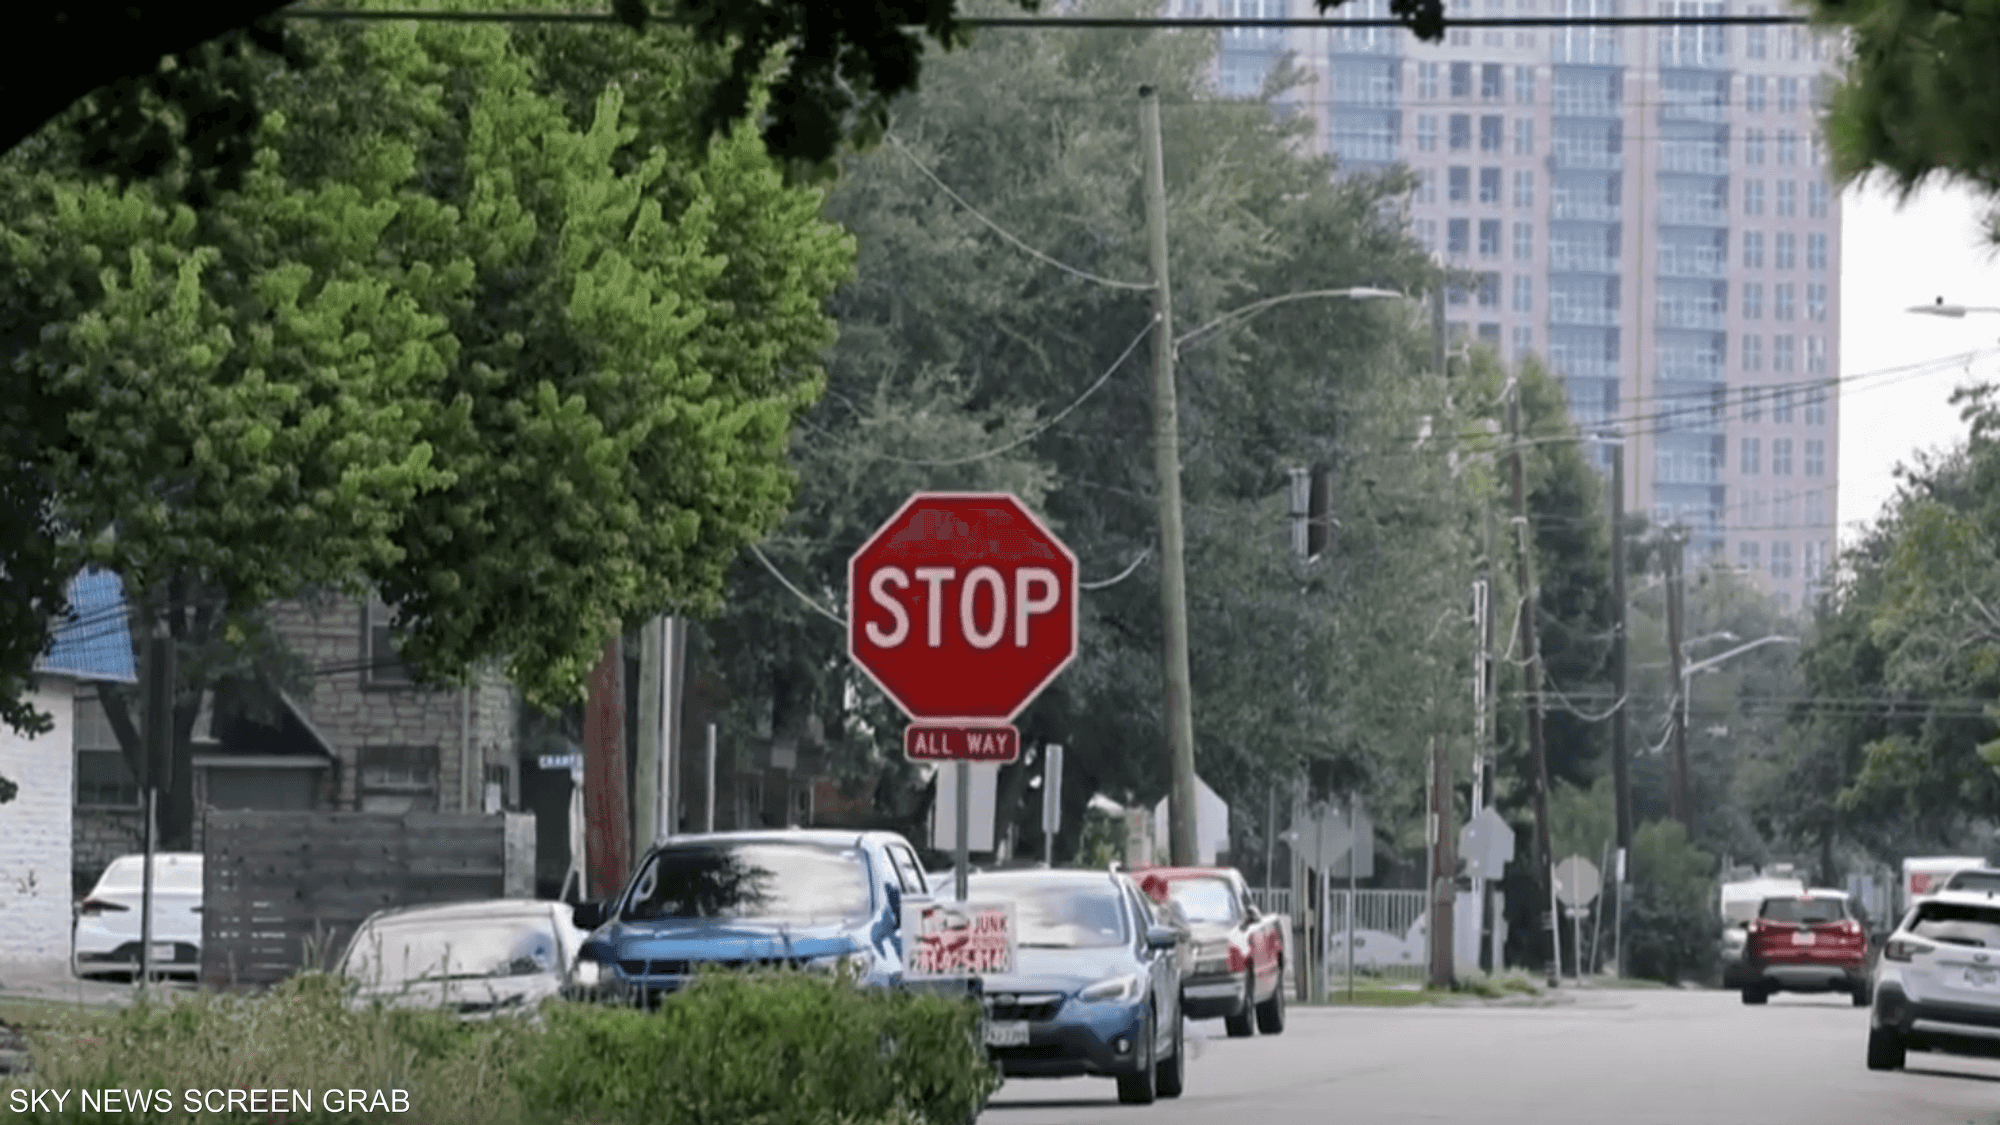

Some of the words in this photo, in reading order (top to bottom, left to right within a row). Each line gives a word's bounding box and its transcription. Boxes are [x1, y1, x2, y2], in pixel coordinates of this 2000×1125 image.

[865, 565, 1061, 649] STOP
[914, 732, 952, 755] ALL
[966, 732, 1010, 754] WAY
